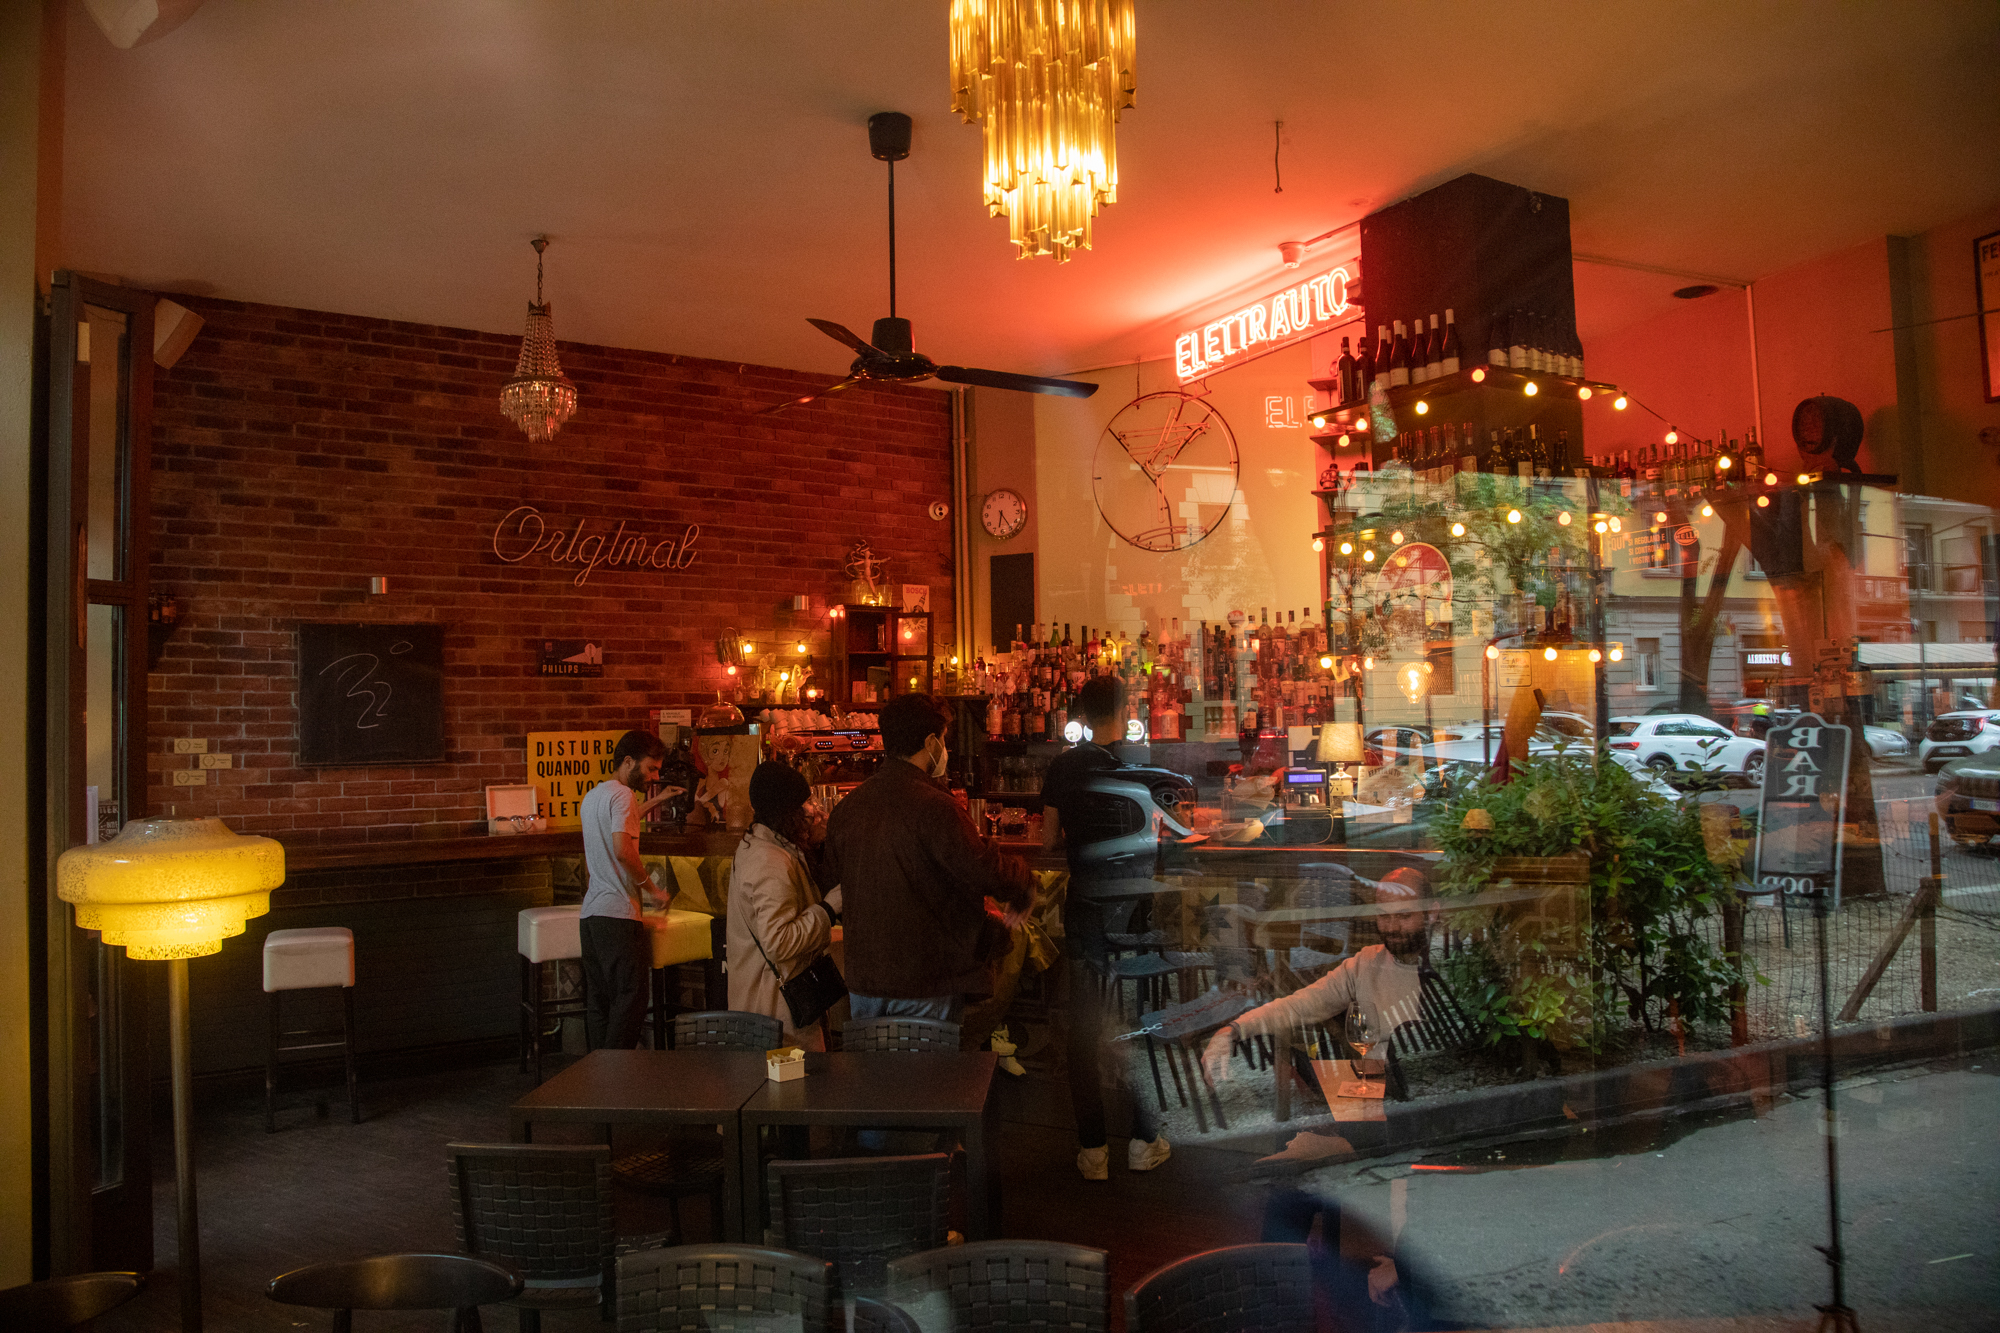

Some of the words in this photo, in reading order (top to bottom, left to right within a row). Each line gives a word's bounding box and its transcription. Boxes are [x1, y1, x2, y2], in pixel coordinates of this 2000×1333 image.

[1982, 241, 2000, 262] FE
[1175, 266, 1351, 379] ELETTRAUTO
[493, 505, 700, 587] Original
[905, 586, 928, 595] BOSCH
[542, 664, 579, 674] PHILIPS
[536, 739, 614, 757] DISTURB
[536, 759, 590, 778] QUANDO
[599, 759, 615, 775] VO
[550, 781, 564, 797] IL
[537, 801, 580, 818] ELET
